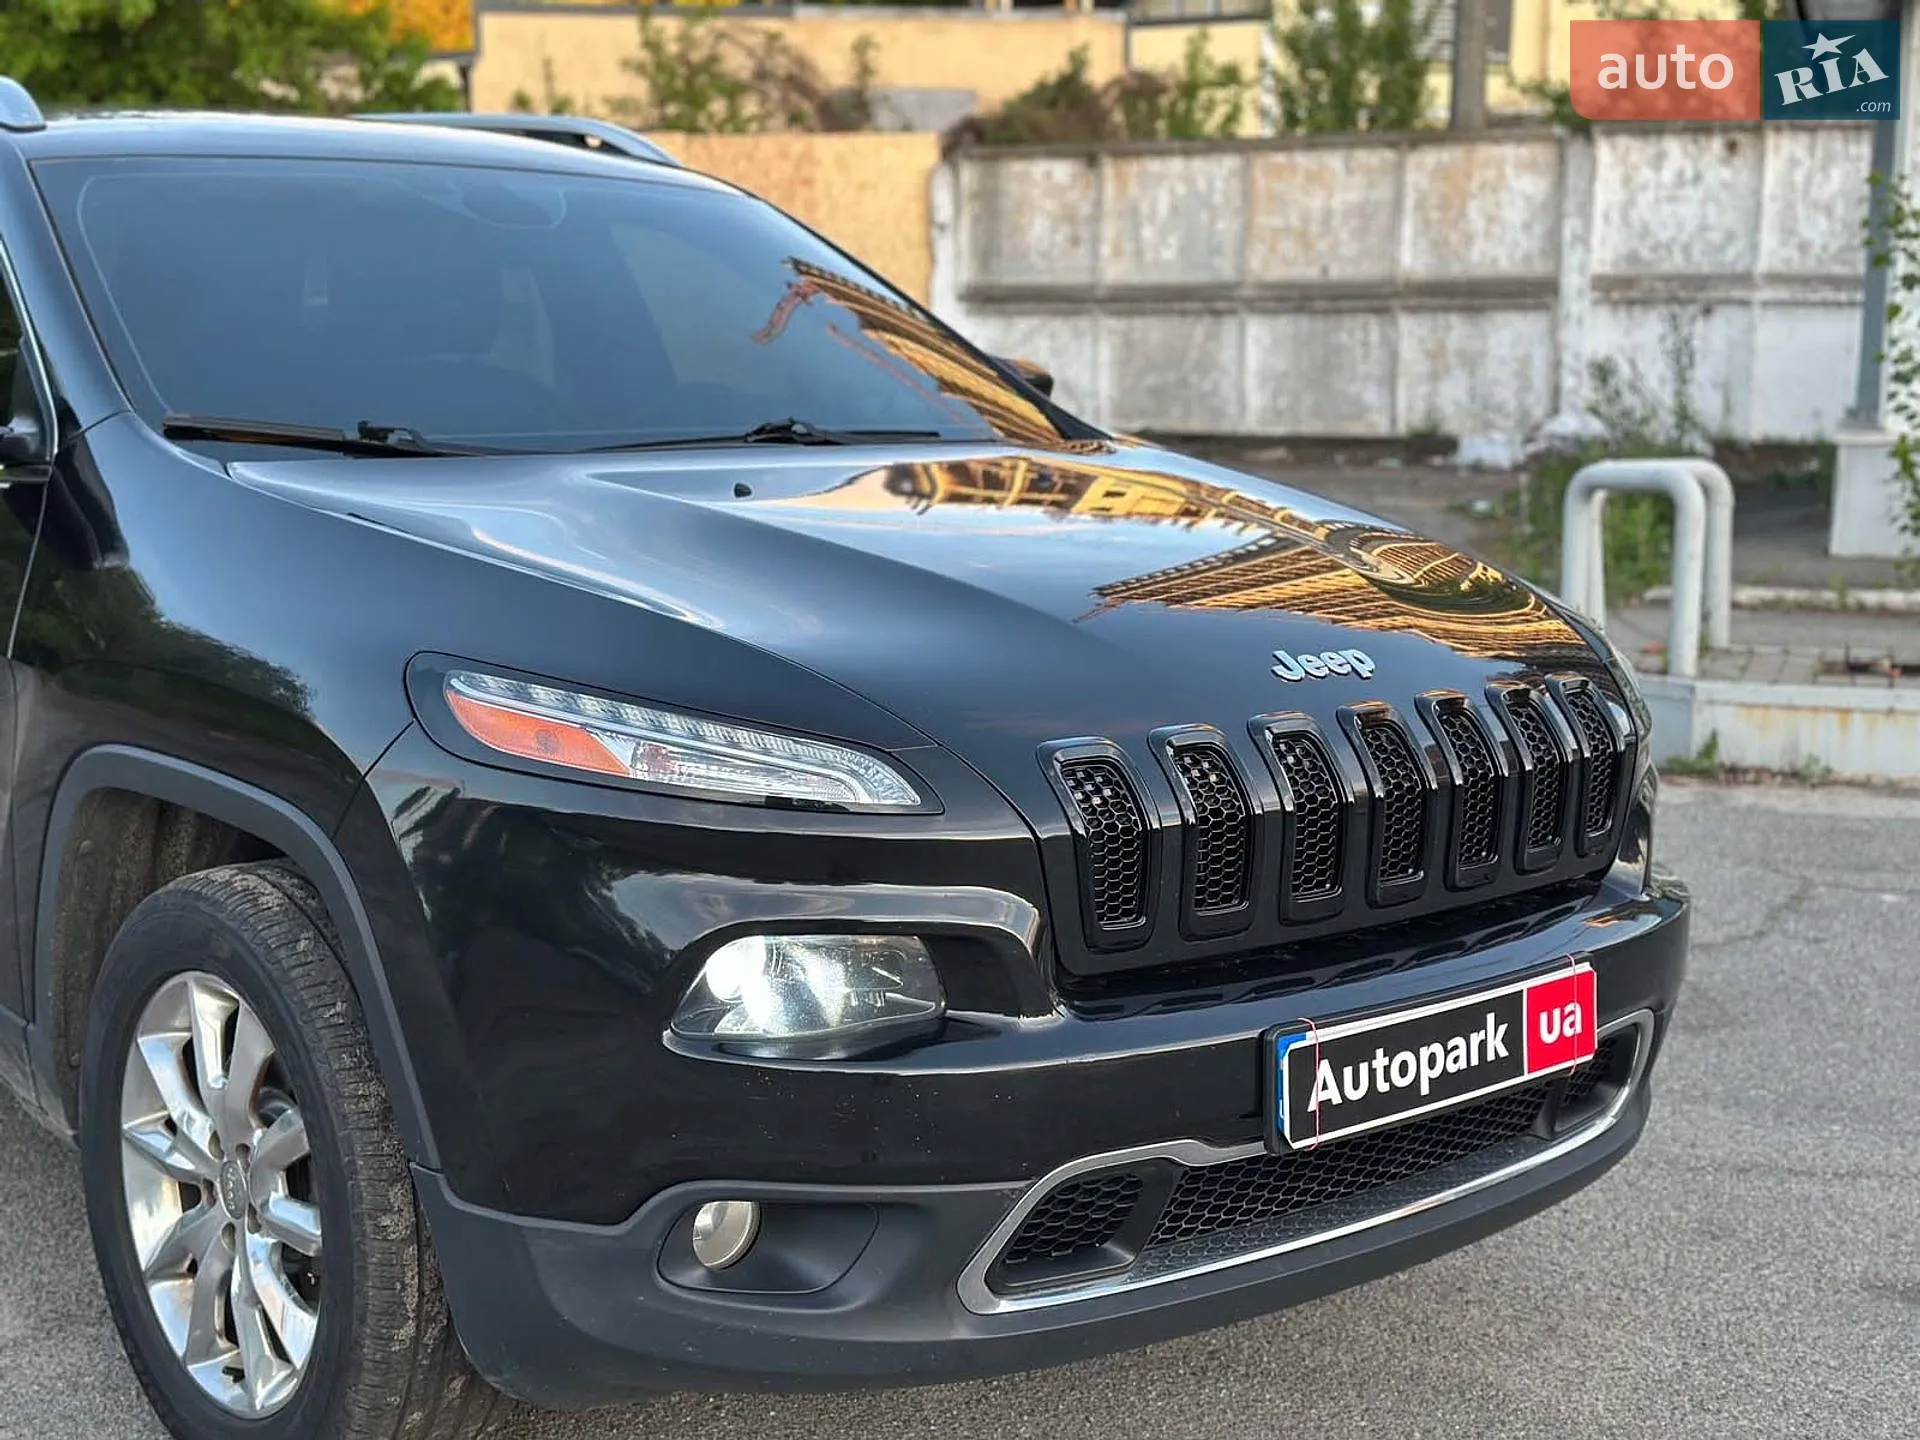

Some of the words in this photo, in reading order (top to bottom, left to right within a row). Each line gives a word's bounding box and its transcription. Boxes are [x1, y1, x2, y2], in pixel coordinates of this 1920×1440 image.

[1271, 649, 1376, 681] Jeep
[1307, 1012, 1509, 1112] Autopark
[1538, 1000, 1583, 1044] ua
